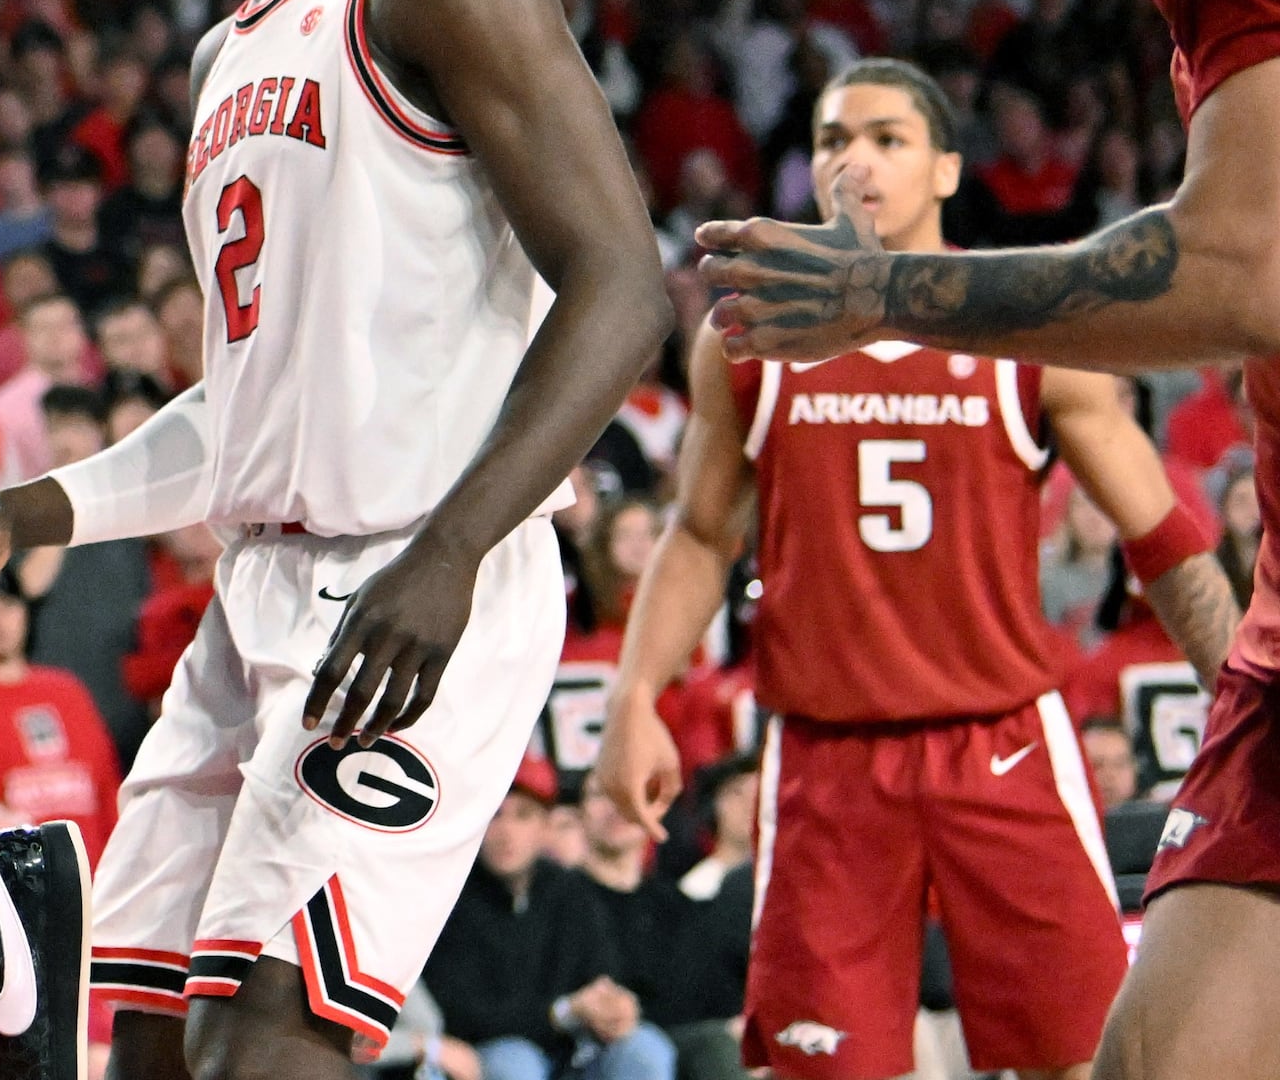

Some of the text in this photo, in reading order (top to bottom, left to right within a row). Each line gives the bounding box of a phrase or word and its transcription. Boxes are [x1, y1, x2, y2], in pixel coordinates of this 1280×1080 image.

[214, 174, 265, 345] 2
[789, 392, 990, 428] ARKANSAS
[857, 438, 934, 553] 5
[301, 734, 436, 828] G
